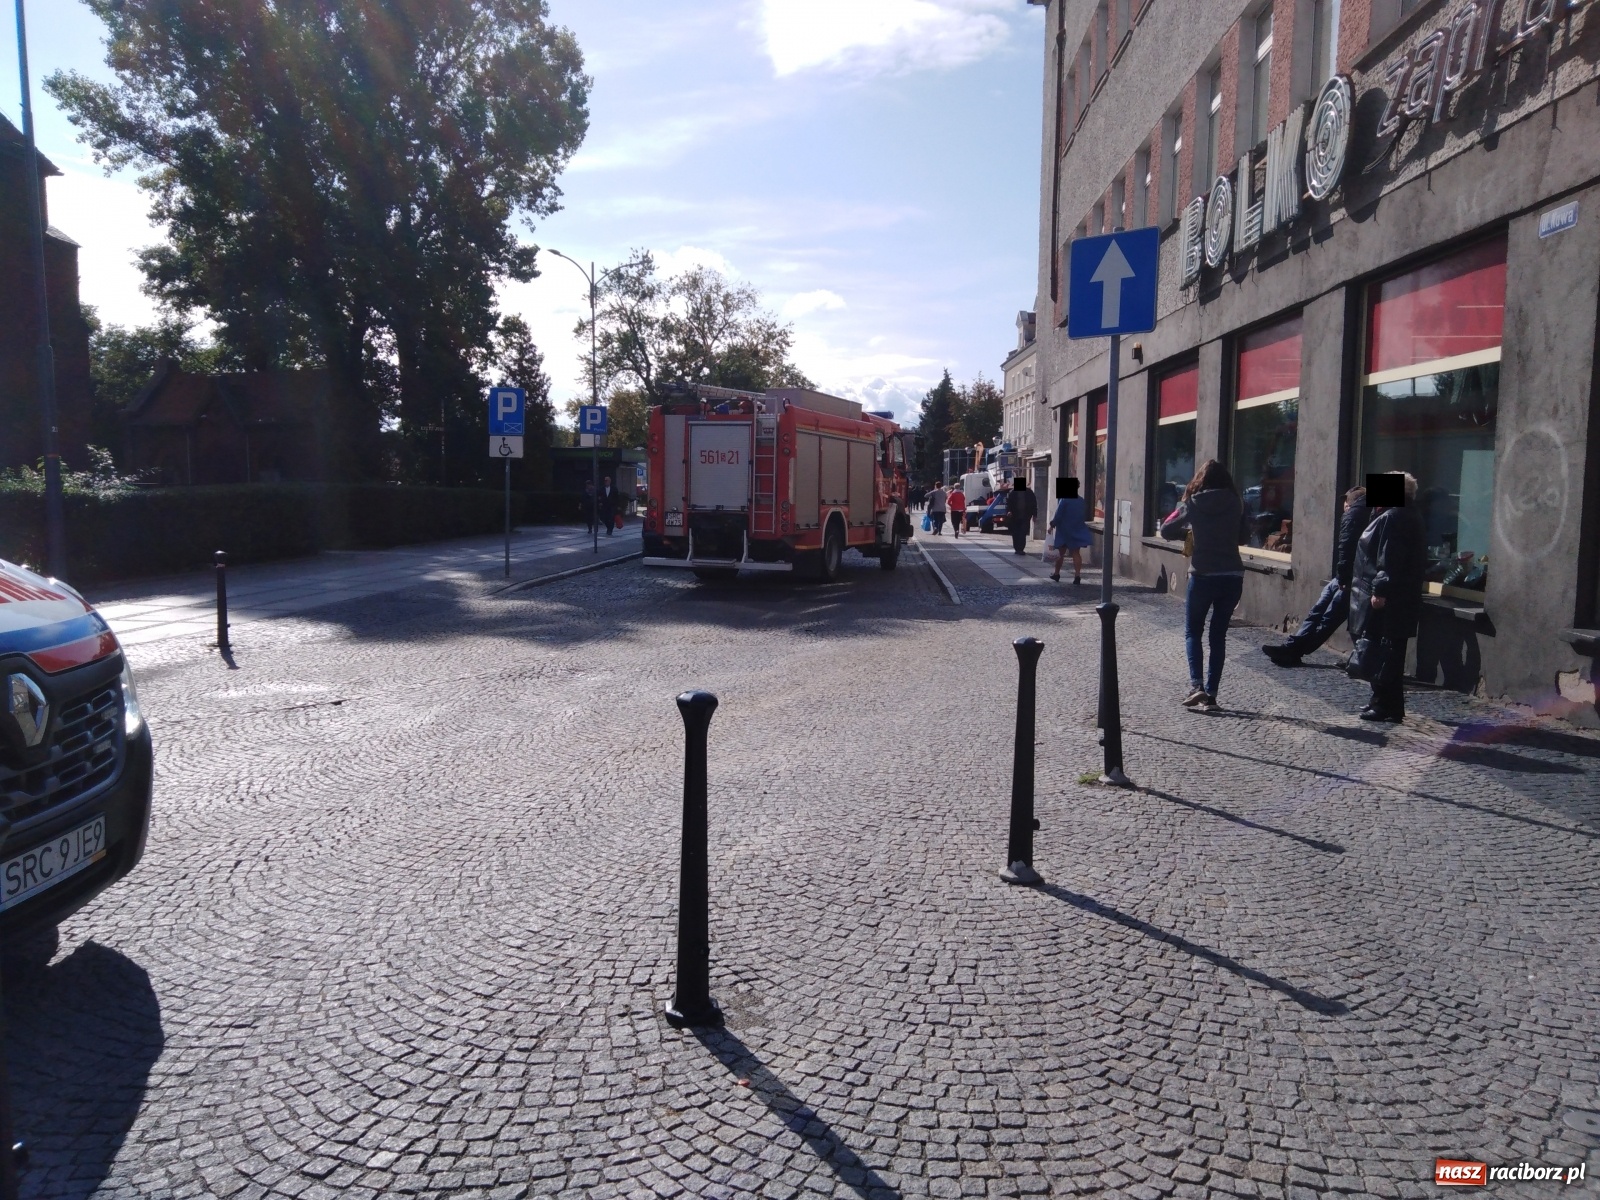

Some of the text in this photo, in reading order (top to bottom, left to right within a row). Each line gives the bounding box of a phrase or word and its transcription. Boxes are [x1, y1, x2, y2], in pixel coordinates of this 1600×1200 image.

[497, 391, 517, 421] P
[585, 408, 602, 430] P
[6, 821, 102, 895] SRC 9JE9
